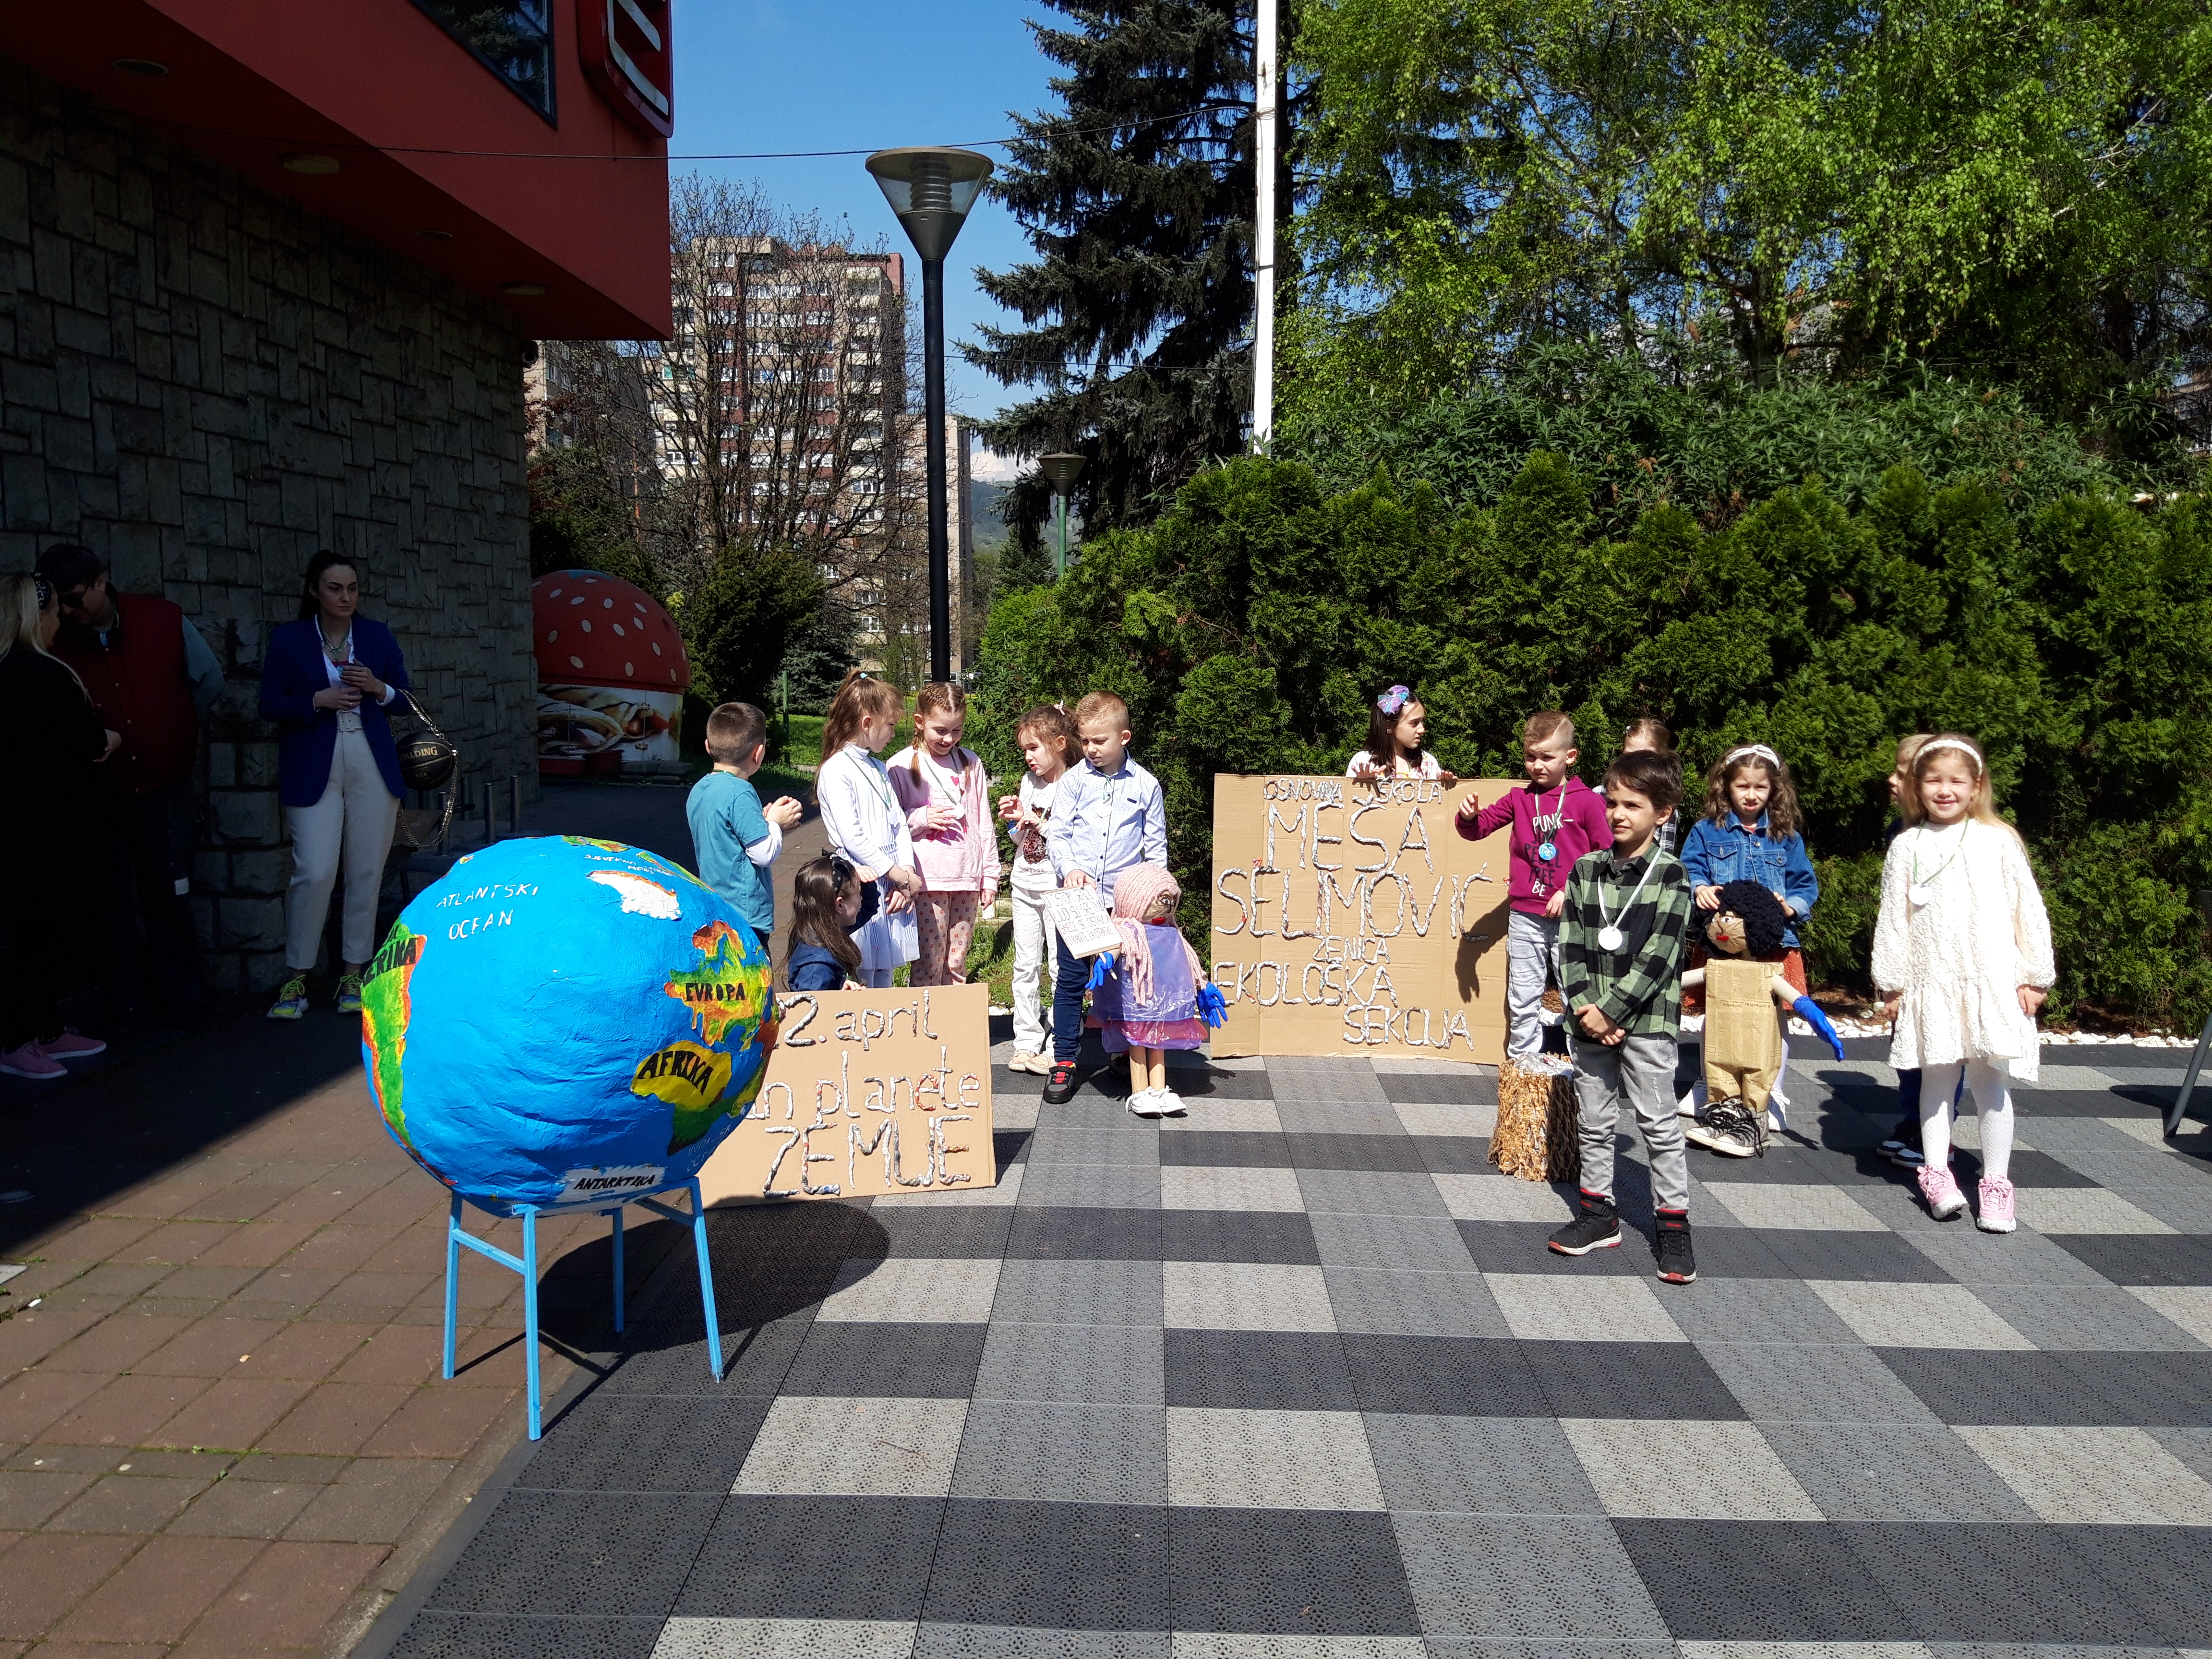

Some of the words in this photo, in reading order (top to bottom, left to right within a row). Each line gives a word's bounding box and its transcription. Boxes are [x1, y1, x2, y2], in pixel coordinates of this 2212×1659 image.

[399, 746, 438, 762] PALDING
[1267, 793, 1434, 874] MEŠA
[436, 883, 538, 908] ATLANTSKI
[1214, 862, 1493, 942] SELIMOVIĆ
[1532, 880, 1546, 897] BE
[1312, 934, 1391, 964] ZENICA
[685, 981, 745, 1003] EVROPA
[834, 989, 939, 1051] april
[637, 1049, 713, 1095] AFRIKA
[816, 1045, 980, 1125] planete
[573, 1174, 656, 1190] ANTARKTIKA
